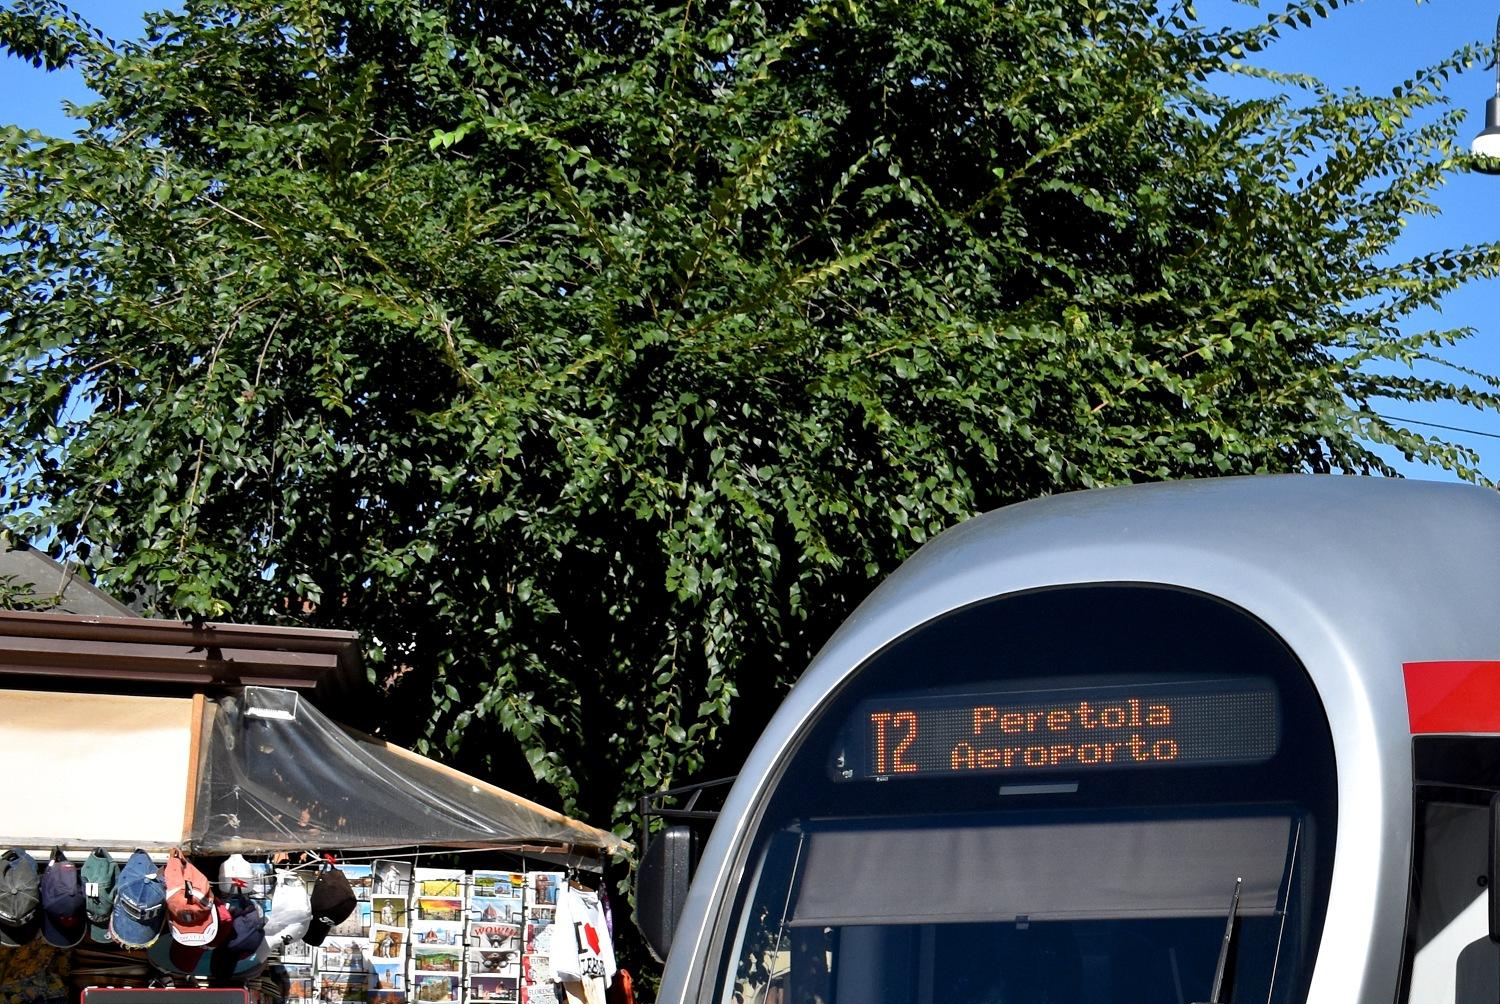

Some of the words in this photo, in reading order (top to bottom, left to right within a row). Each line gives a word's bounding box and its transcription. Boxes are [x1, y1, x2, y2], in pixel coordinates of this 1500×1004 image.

[972, 698, 1173, 736] Peretola
[870, 711, 918, 774] T2
[951, 733, 1179, 770] Aeroporto
